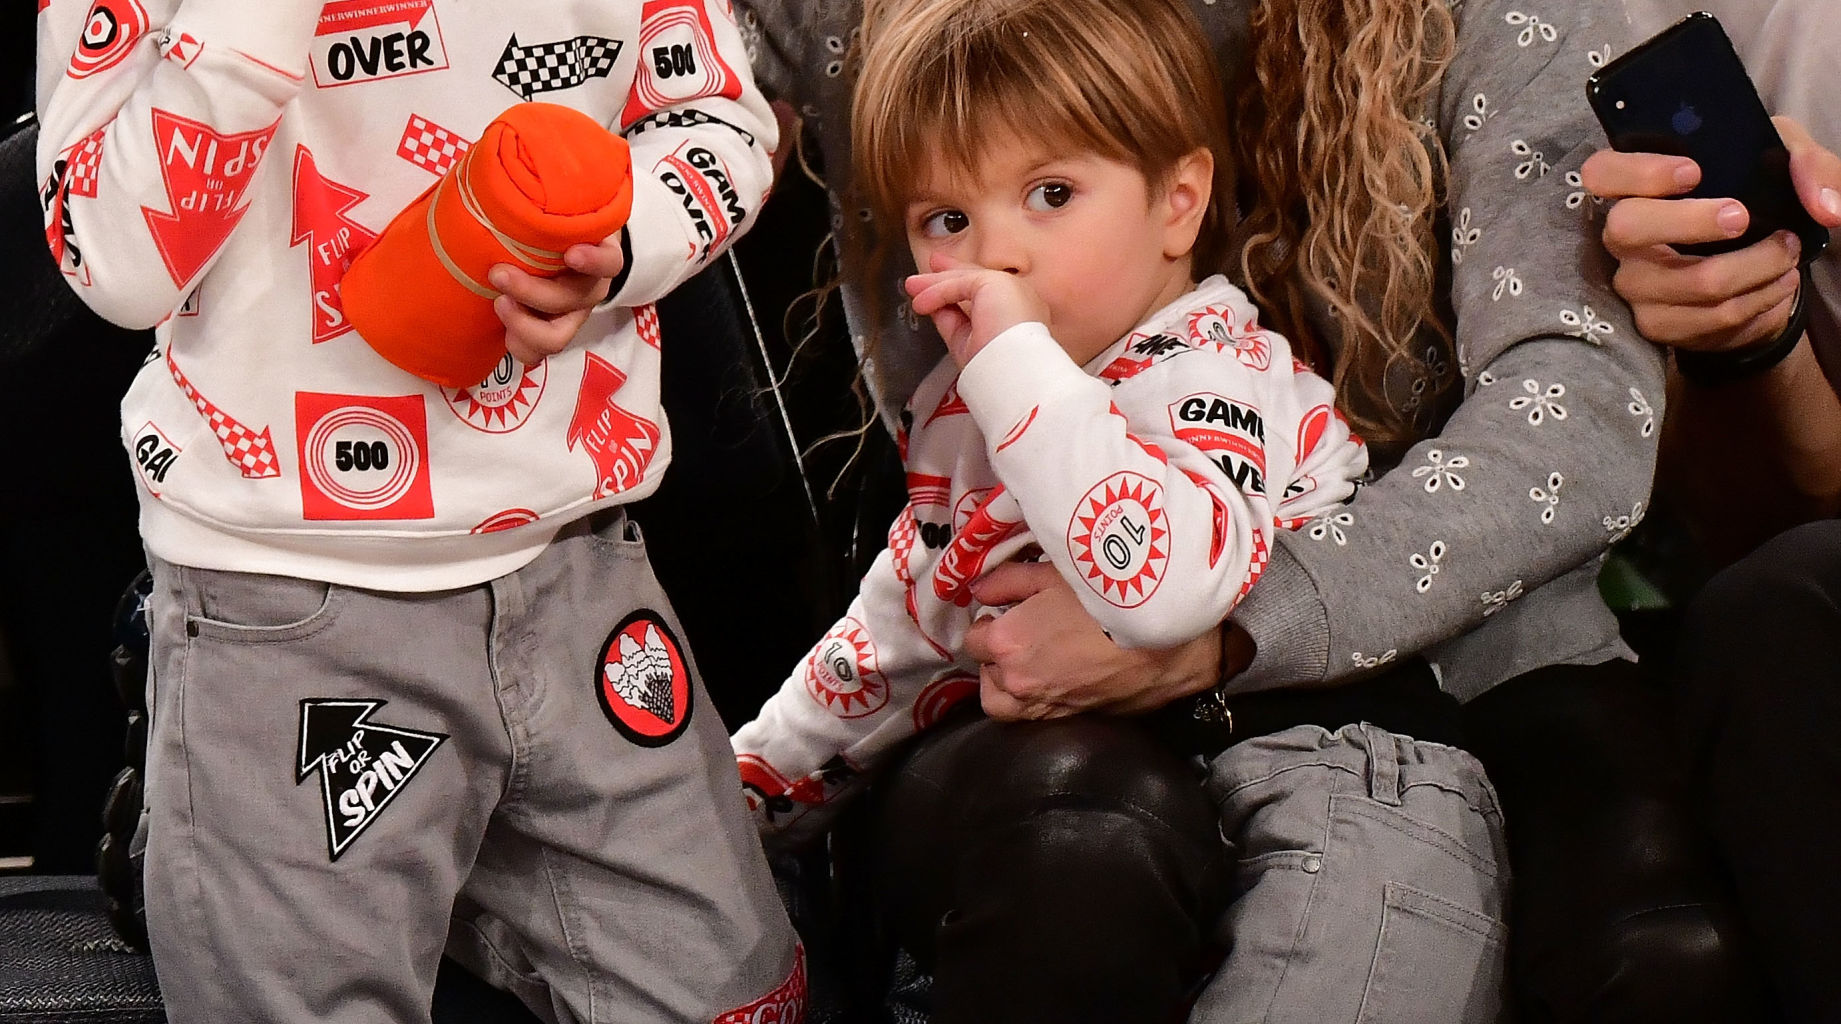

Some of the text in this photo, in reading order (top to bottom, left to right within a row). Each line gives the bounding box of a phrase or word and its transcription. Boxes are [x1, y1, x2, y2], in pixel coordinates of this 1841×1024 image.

[327, 30, 434, 81] OVER
[166, 126, 268, 177] SPIN
[686, 147, 746, 232] GAM
[317, 226, 350, 266] FLIP
[479, 387, 513, 403] POINTS
[586, 408, 611, 453] FLIP
[335, 440, 389, 472] 500
[1093, 504, 1124, 543] POINTS
[1103, 515, 1146, 570] 10
[824, 641, 853, 682] 10
[327, 729, 365, 774] FLIP
[349, 749, 372, 775] OR
[338, 740, 415, 828] SPIN
